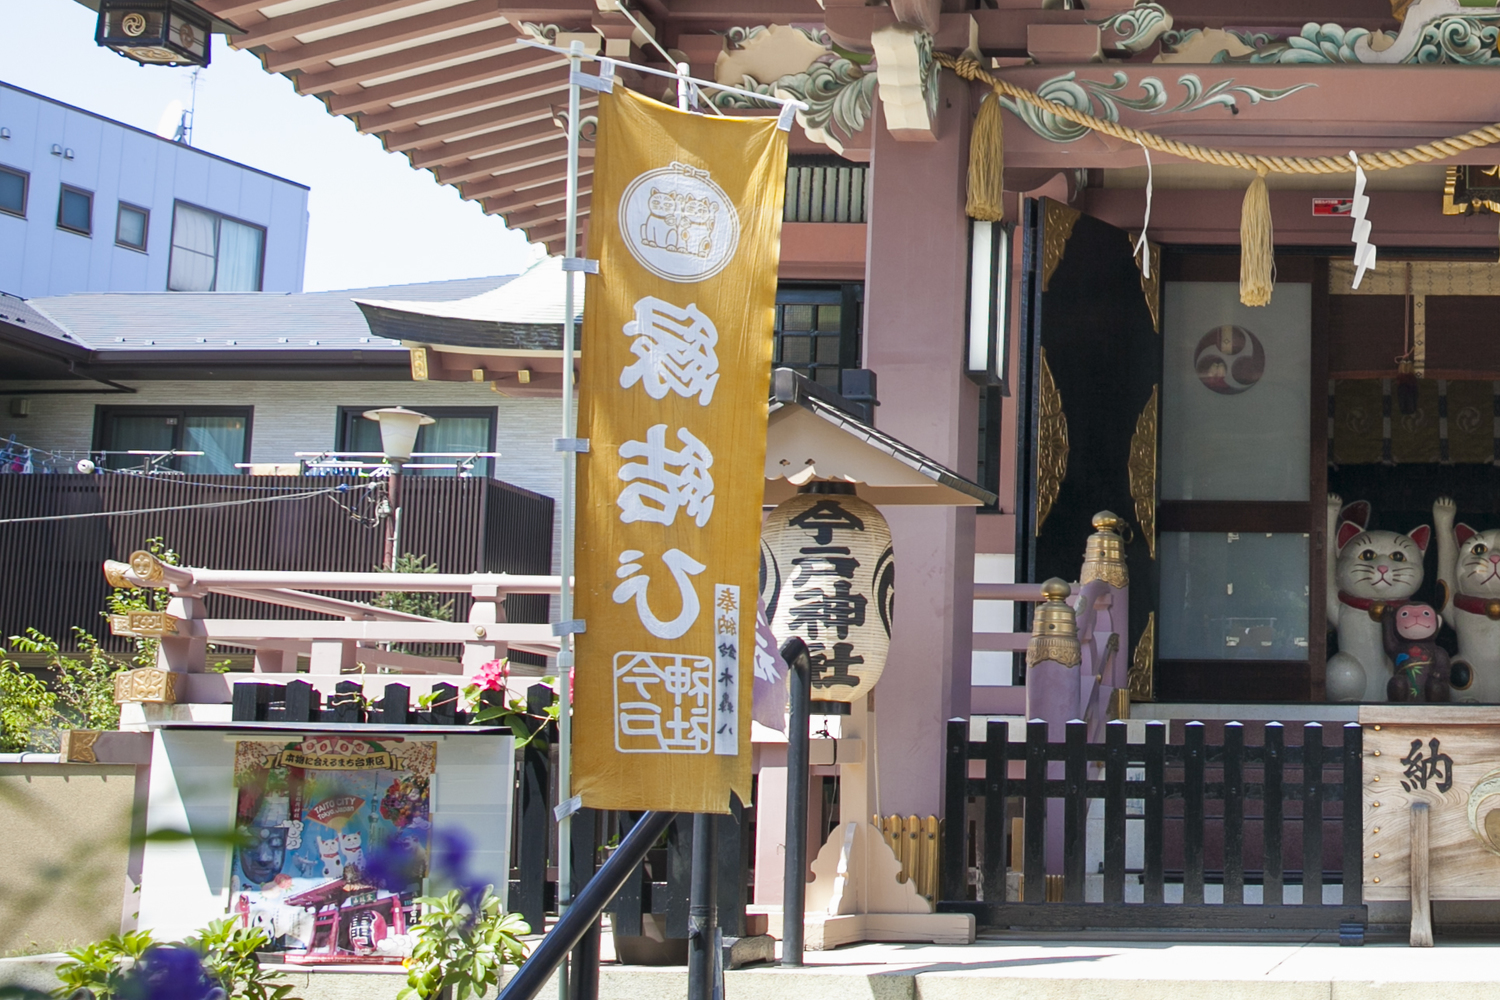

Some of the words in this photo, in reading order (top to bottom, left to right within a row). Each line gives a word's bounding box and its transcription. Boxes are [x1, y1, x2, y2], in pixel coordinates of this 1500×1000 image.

[788, 499, 866, 690] 今戸神社
[284, 753, 386, 768] 本物に会えるまち台東区
[1400, 737, 1454, 794] 納
[314, 799, 335, 814] TAITO
